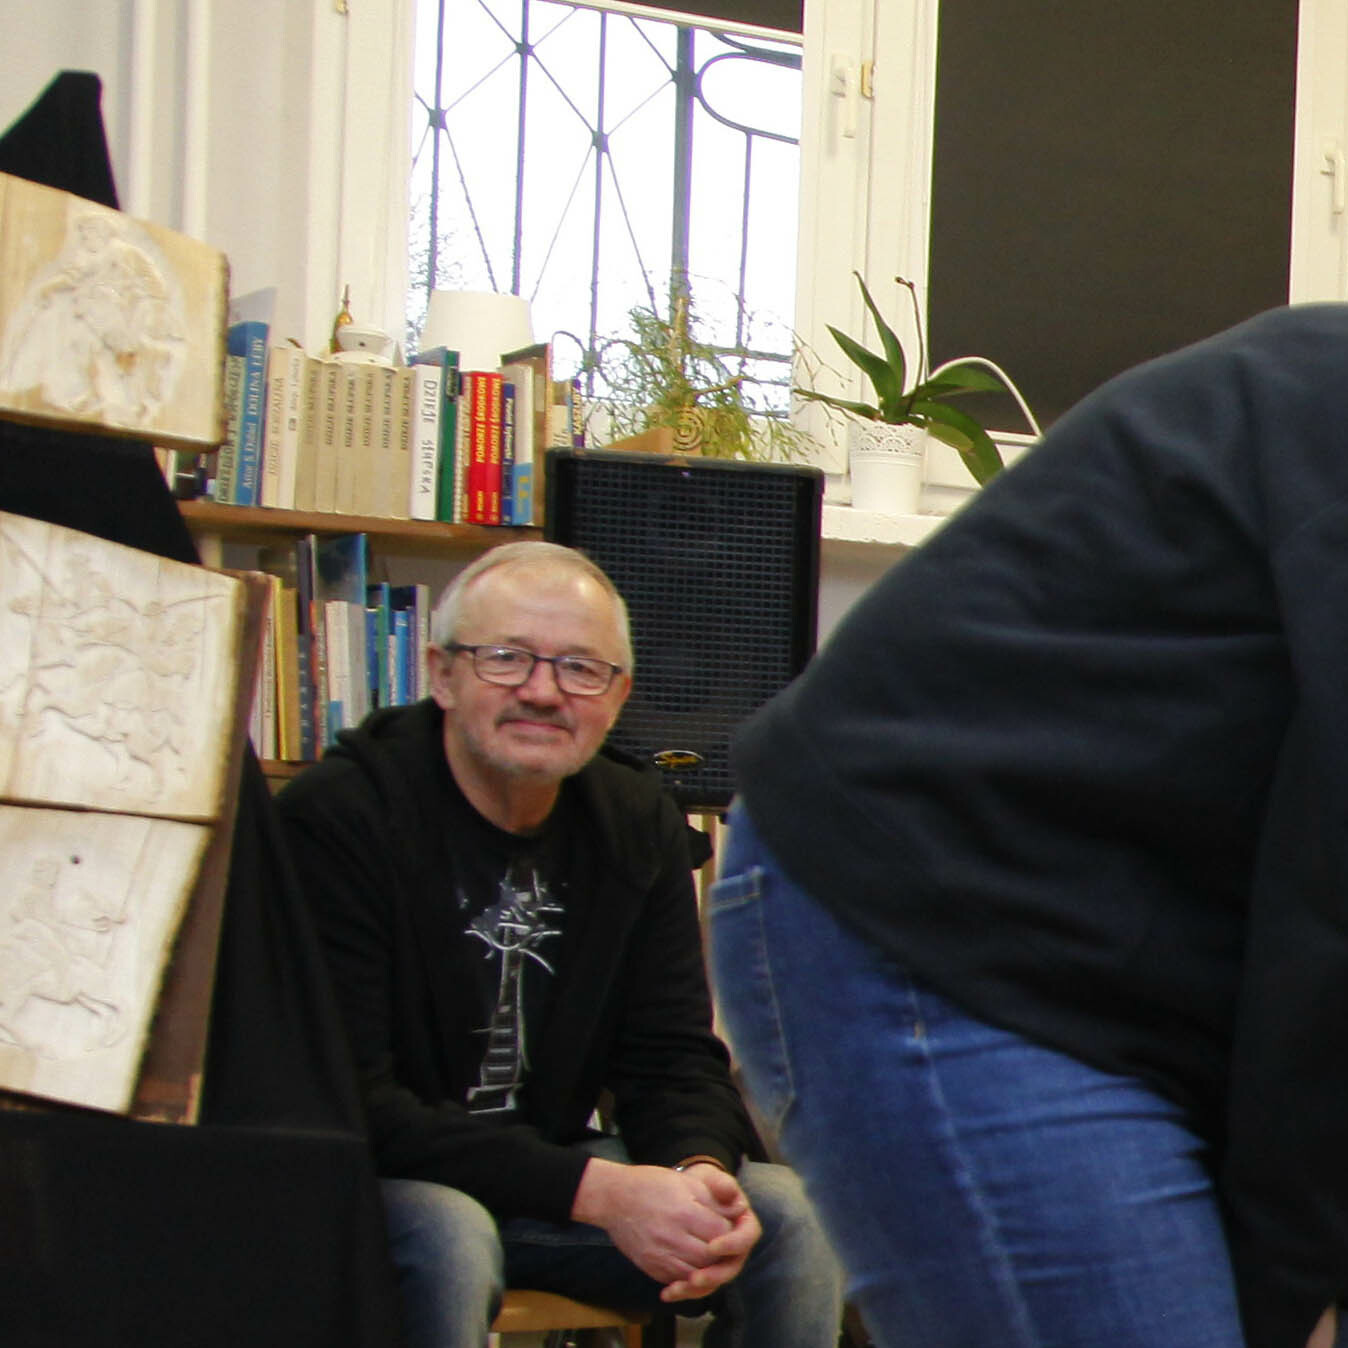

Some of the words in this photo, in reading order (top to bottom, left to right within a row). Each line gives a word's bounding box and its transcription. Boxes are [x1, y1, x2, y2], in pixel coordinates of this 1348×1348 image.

[247, 371, 262, 416] DOLINA
[420, 379, 438, 424] DZIEJE
[475, 423, 487, 463] POMORZE
